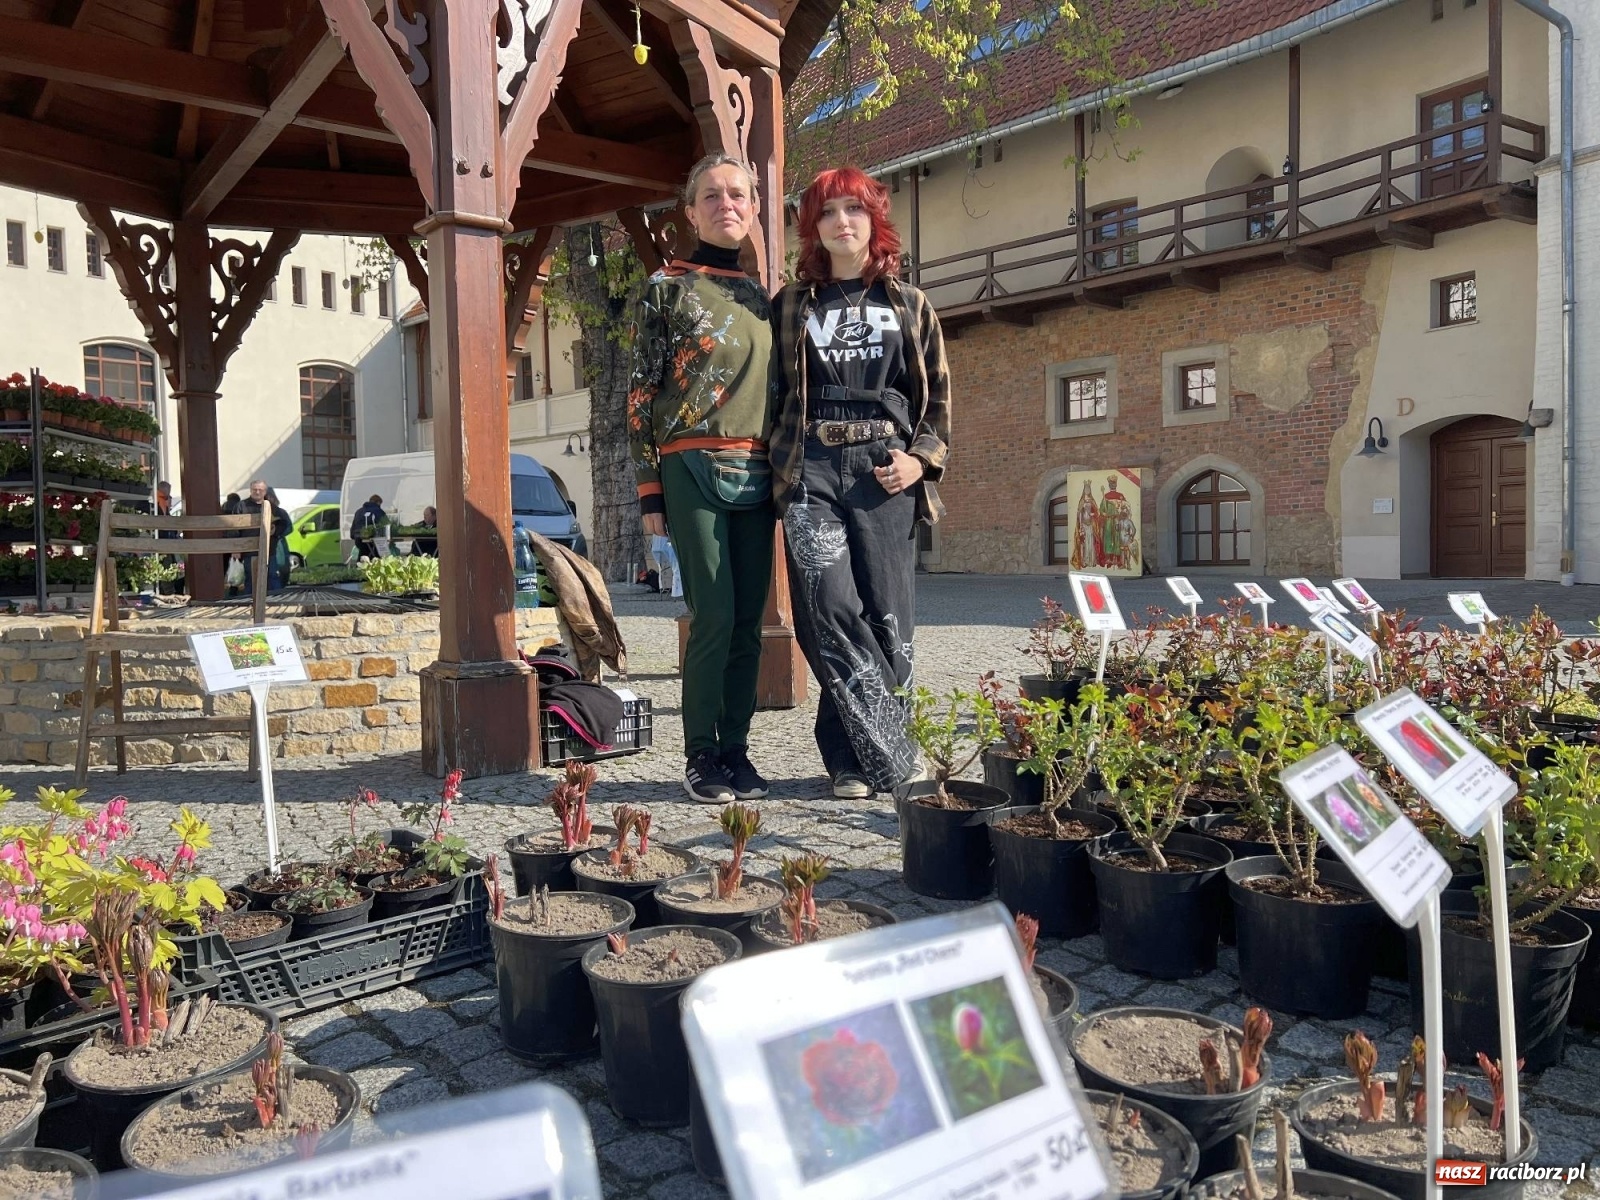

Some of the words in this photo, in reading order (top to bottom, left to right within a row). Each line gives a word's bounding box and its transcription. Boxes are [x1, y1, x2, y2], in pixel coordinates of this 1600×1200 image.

[805, 305, 900, 346] VIP
[818, 345, 884, 363] VYPYR
[1396, 397, 1415, 417] D
